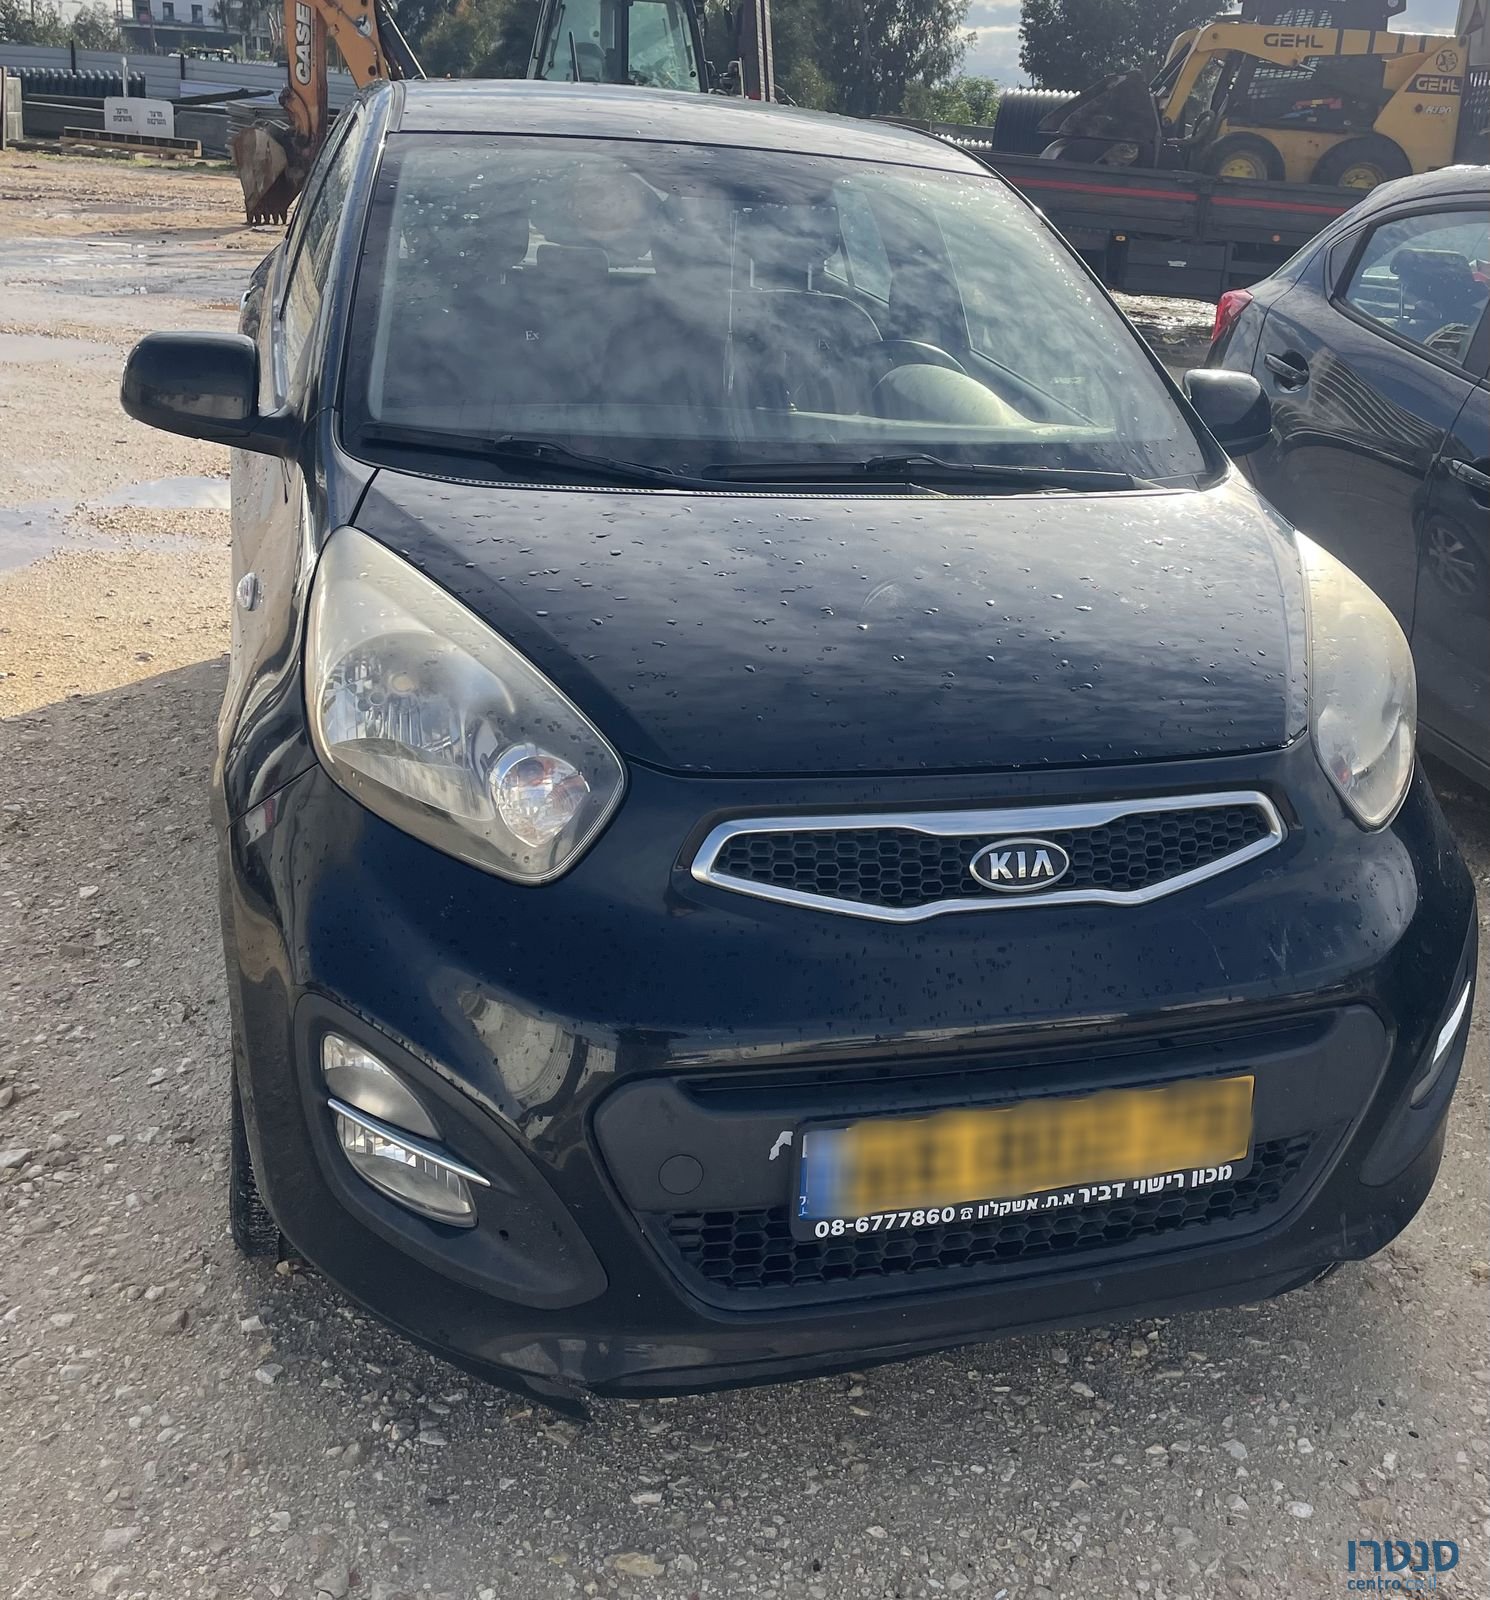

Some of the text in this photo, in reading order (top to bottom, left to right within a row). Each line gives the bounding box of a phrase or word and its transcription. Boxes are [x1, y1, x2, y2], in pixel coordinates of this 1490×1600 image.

[296, 2, 311, 85] CASE
[1264, 33, 1324, 48] GEHL
[1416, 77, 1460, 92] GEHL
[989, 850, 1055, 880] KIA
[1133, 1174, 1185, 1195] רישוי
[1191, 1165, 1233, 1187] מכון
[1079, 1183, 1126, 1203] דביר
[977, 1198, 1039, 1219] אשקלון
[815, 1207, 956, 1238] 08-6777860
